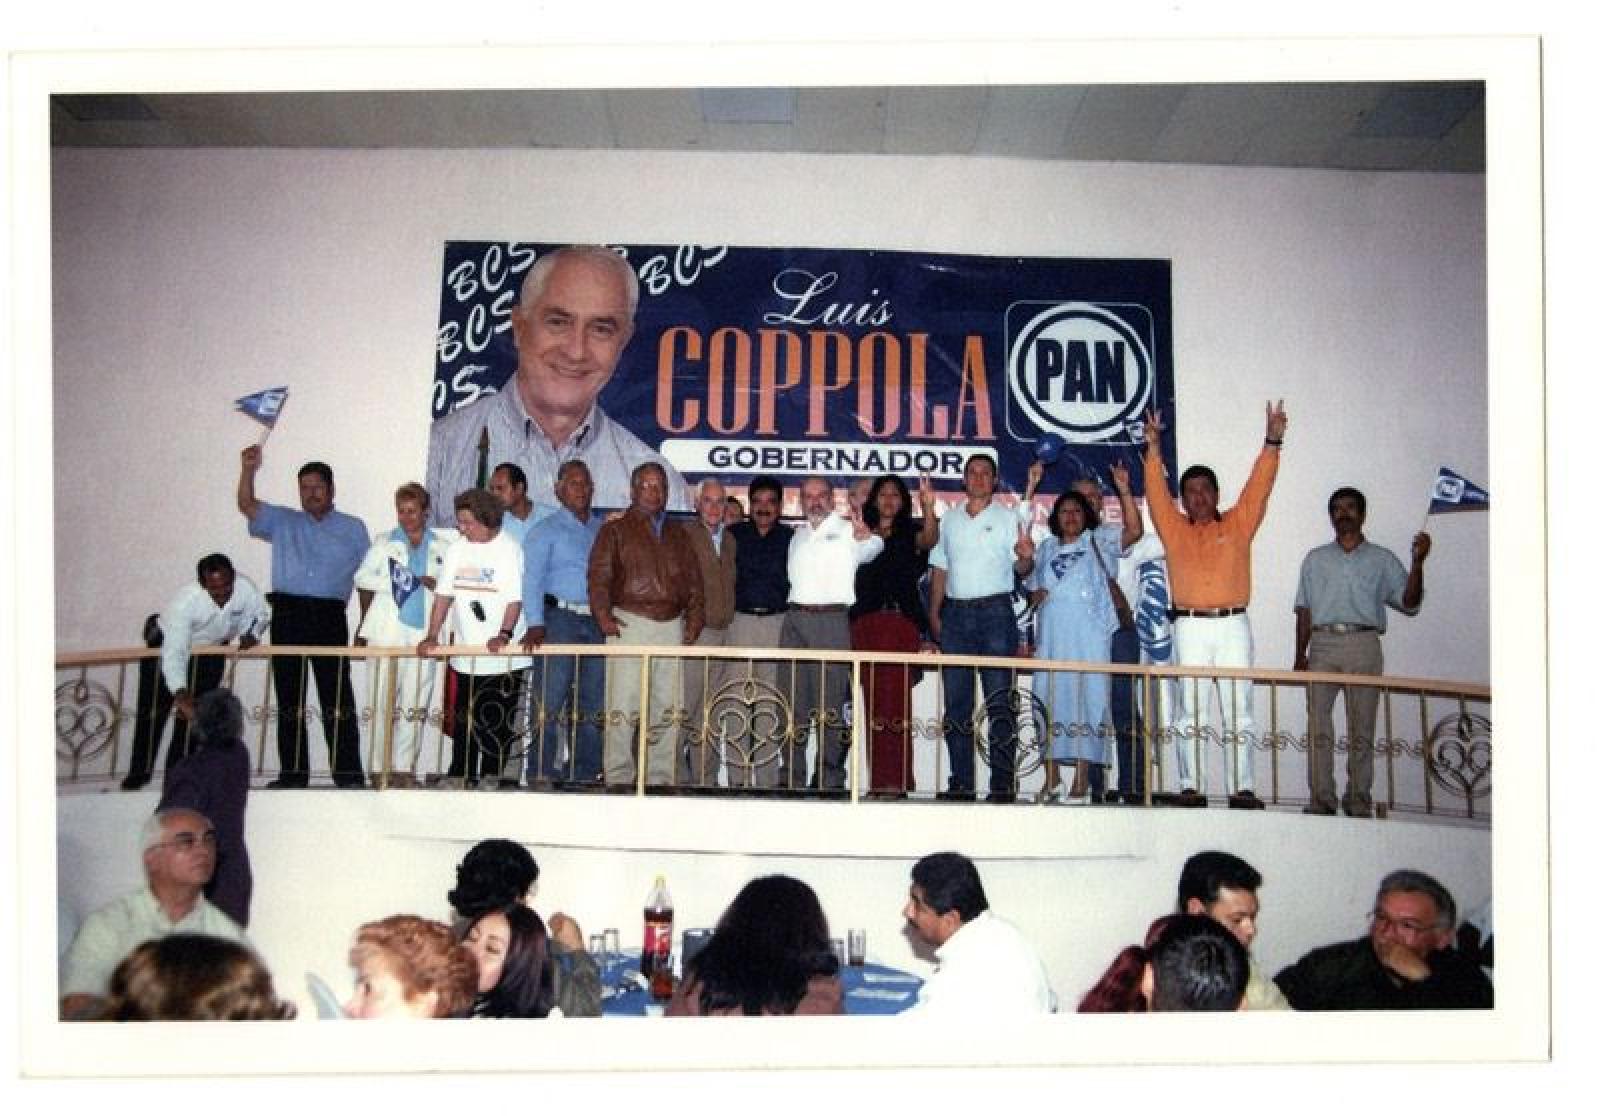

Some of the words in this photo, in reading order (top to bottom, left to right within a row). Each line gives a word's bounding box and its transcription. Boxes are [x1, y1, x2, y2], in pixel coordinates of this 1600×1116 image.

[448, 241, 536, 302] BCS
[763, 268, 894, 325] Luis
[438, 290, 515, 363] BCS
[656, 326, 997, 440] COPPOLA
[1036, 337, 1127, 403] PAN
[708, 446, 964, 474] GOBERNADOR
